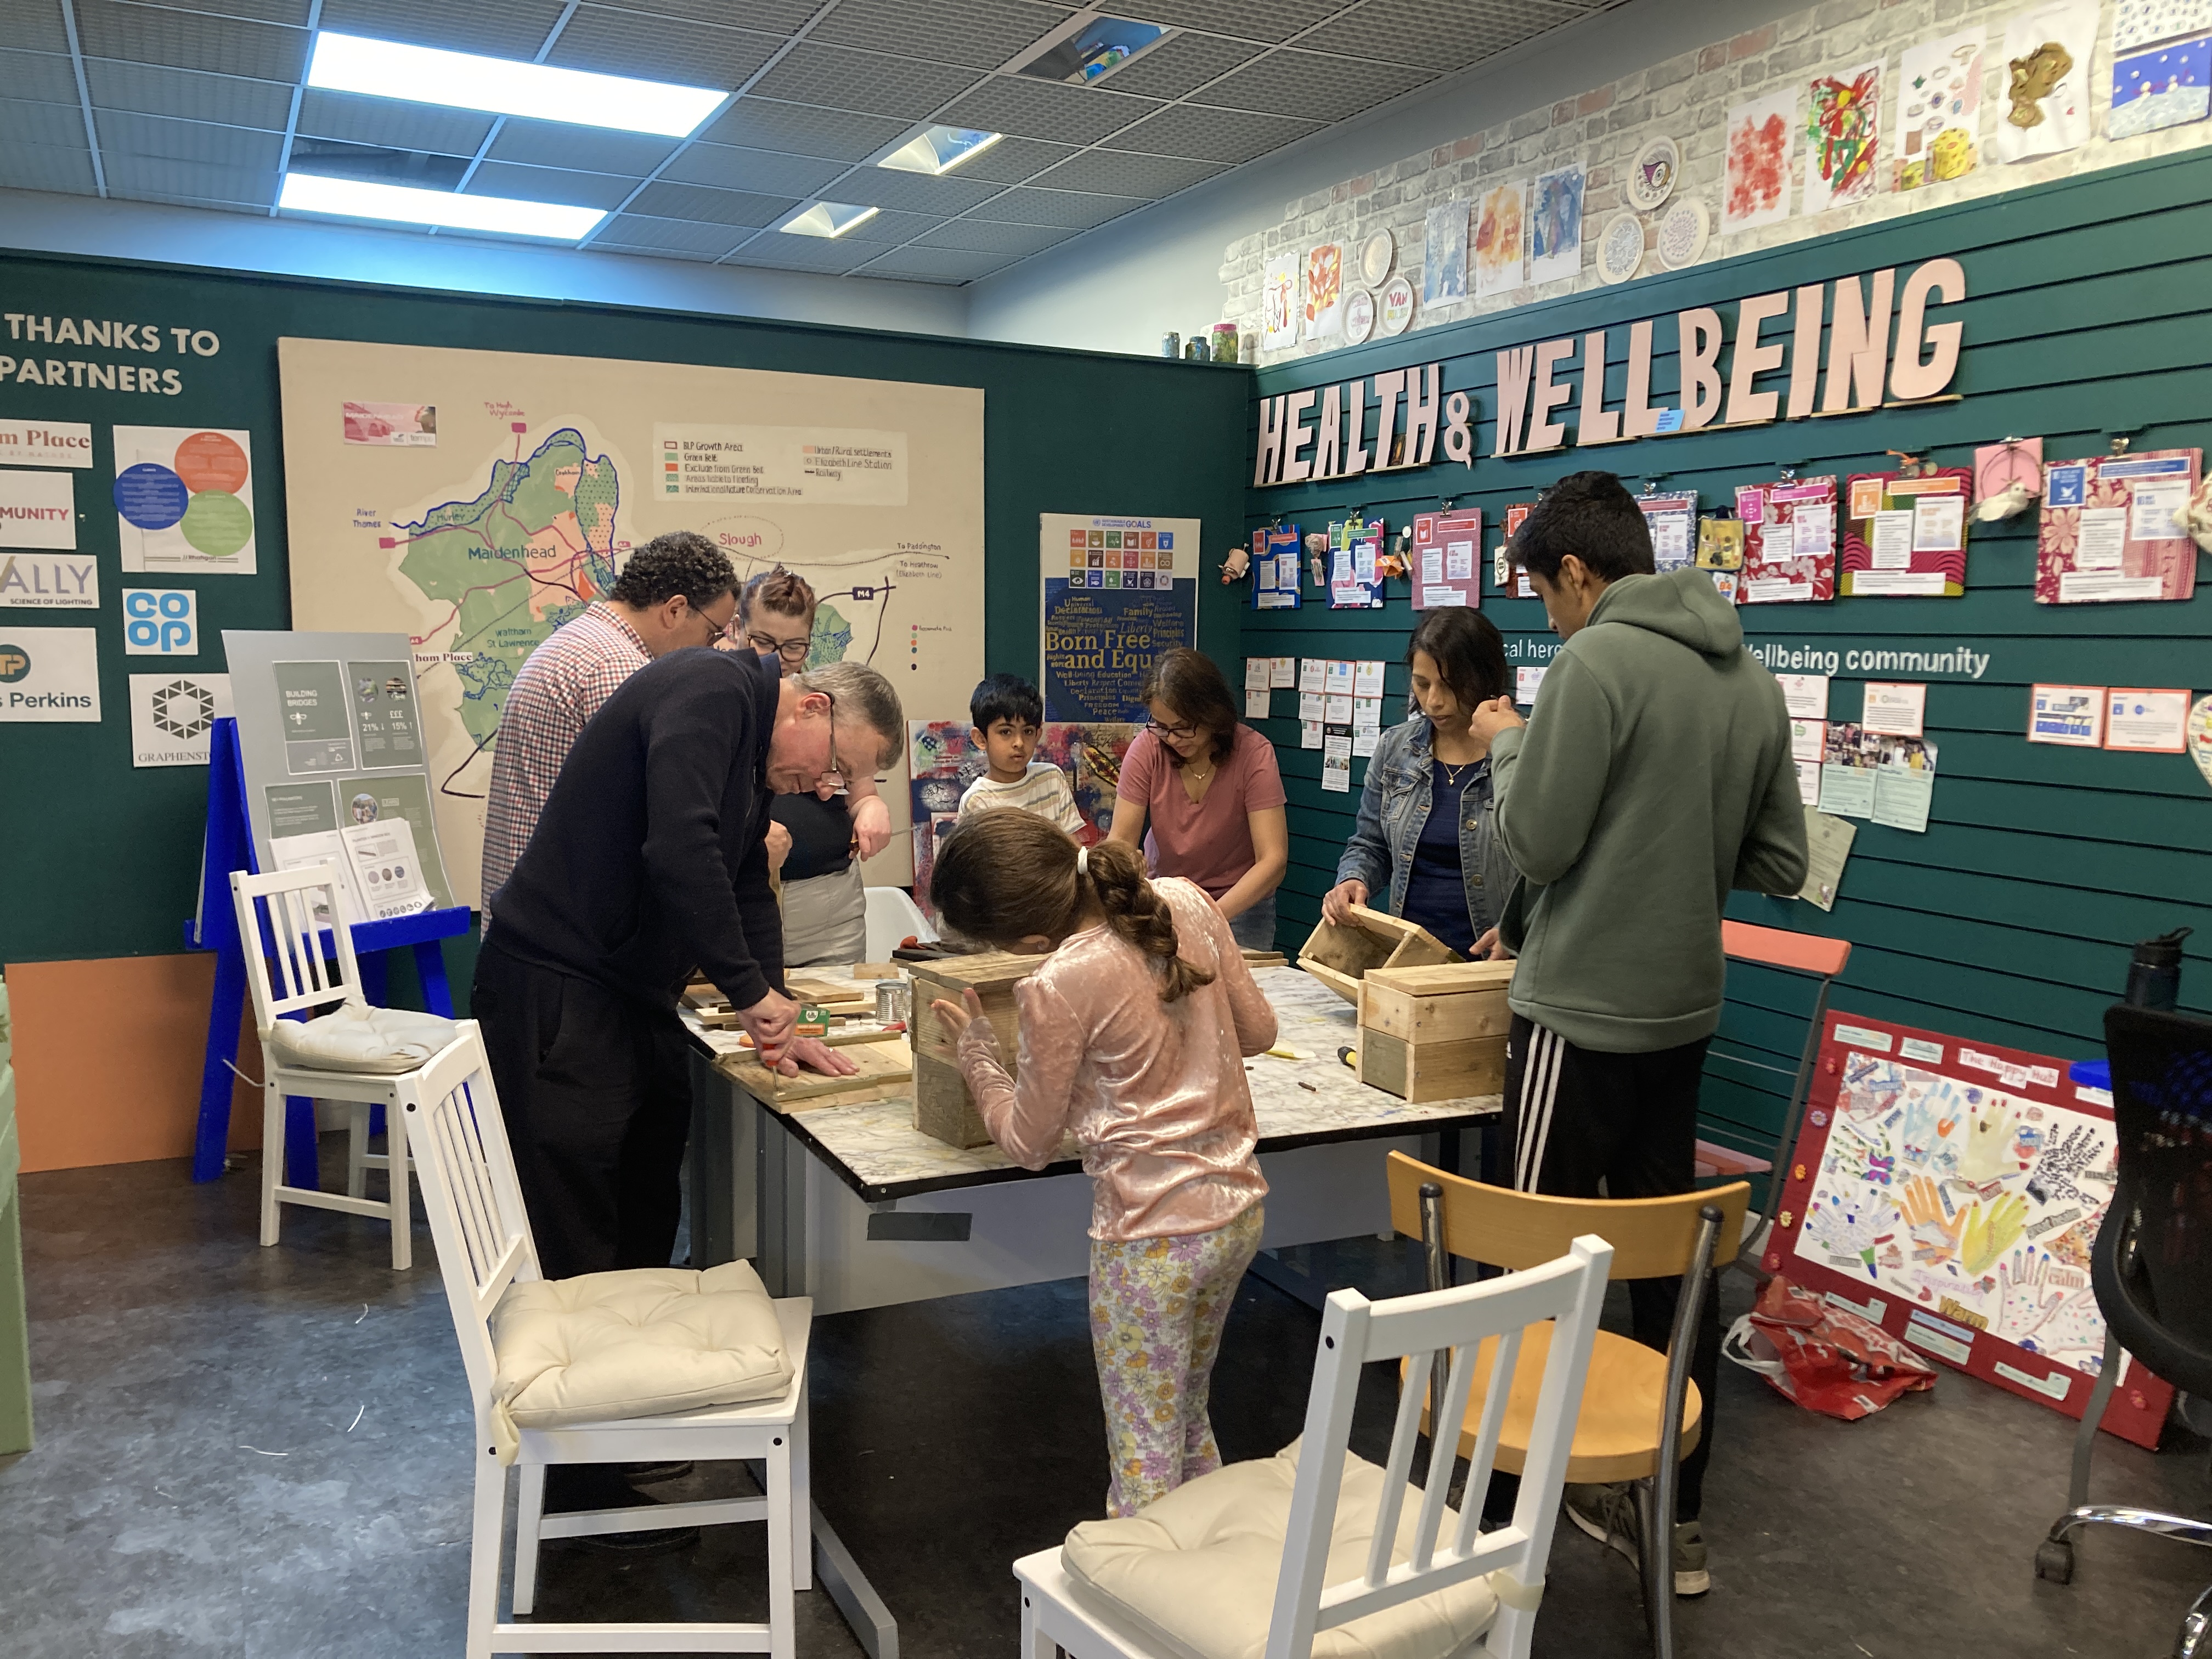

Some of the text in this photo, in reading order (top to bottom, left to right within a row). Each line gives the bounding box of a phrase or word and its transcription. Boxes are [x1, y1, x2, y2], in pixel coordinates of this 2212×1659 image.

[1389, 291, 1408, 307] VAN
[4, 313, 220, 357] THANKS TO
[0, 356, 183, 396] PARTNERS
[1254, 362, 1443, 487] HEALTH
[1444, 391, 1472, 470] &
[26, 430, 90, 448] Place
[696, 442, 722, 450] Growth
[724, 443, 743, 452] Area
[854, 447, 892, 458] settlements
[684, 453, 718, 462] Green Belt
[685, 464, 713, 472] Exclude
[714, 465, 730, 473] from
[815, 458, 892, 470] Elizabeth Line Station
[816, 469, 841, 481] Railway
[746, 486, 786, 495] Conservation
[357, 509, 376, 517] River
[437, 512, 465, 522] Hurley
[353, 520, 381, 528] Thames
[719, 532, 762, 547] Slough
[907, 541, 941, 551] Paddington
[469, 545, 556, 561] Maidenhead
[1124, 607, 1153, 617] Family
[495, 628, 532, 637] Waltham
[1119, 622, 1152, 634] Liberty
[1153, 627, 1184, 638] Principles
[487, 639, 540, 648] St Lawrence
[1045, 629, 1150, 651] Born Free
[1064, 649, 1105, 669] and
[1845, 646, 1990, 679] community
[1056, 670, 1095, 679] Well-being
[10, 692, 92, 708] Perkins
[1079, 693, 1116, 702] Principles
[390, 710, 404, 719] £££
[363, 723, 379, 732] 21%
[392, 722, 407, 730] 15%
[138, 752, 211, 763] GRAPHENST
[1962, 1051, 2055, 1084] The Happy Hub
[2049, 1271, 2085, 1288] calm
[1939, 1295, 1989, 1331] Warm
